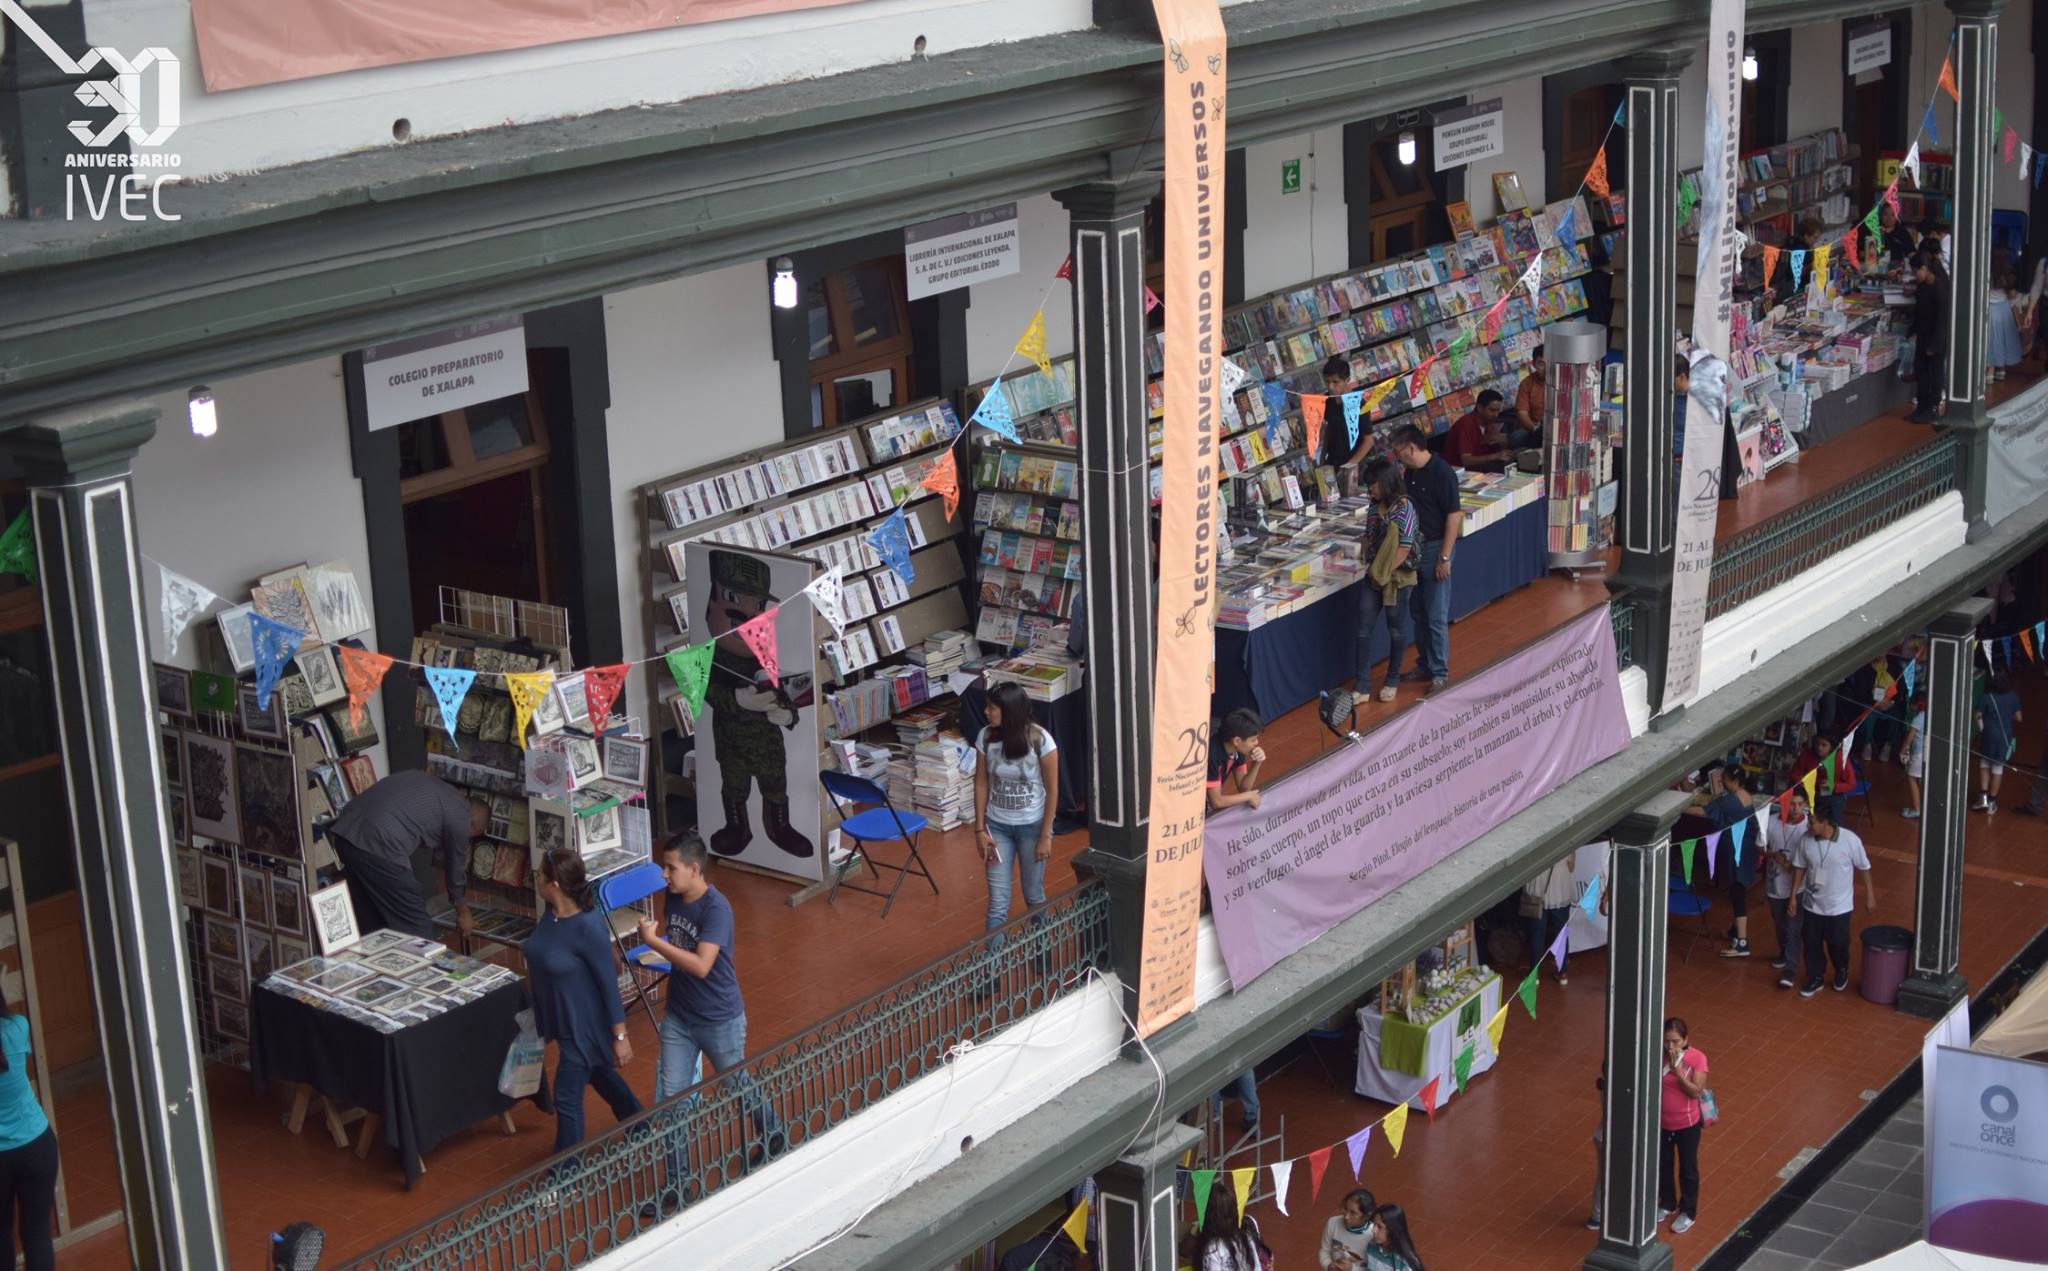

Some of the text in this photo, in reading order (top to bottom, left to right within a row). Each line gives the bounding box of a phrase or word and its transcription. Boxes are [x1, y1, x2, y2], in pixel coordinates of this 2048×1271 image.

[909, 229, 1016, 262] LIBRERÍA INTERNACIONAL DE XALAPA
[928, 259, 1000, 284] GRUPO EDITORIAL ÉXODO
[929, 262, 937, 271] DE
[953, 250, 984, 265] EDICIONES
[1190, 80, 1212, 607] LECTORES NAVEGANDO UNIVERSOS
[388, 350, 504, 387] COLEGIO PREPARATORIO
[422, 375, 475, 397] DE XALAPA
[1682, 539, 1709, 553] 21 AL
[1677, 556, 1712, 573] DE JUL
[1175, 721, 1208, 771] 28
[1175, 769, 1198, 781] Nacional
[1226, 855, 1257, 880] sobre
[1260, 848, 1272, 863] su
[1271, 829, 1306, 855] cuerpo,
[1307, 818, 1320, 834] un
[1321, 805, 1344, 825] topo
[1345, 794, 1363, 815] que
[1365, 782, 1386, 801] cava
[1388, 773, 1399, 788] en
[1400, 767, 1411, 781] su
[1453, 735, 1466, 750] soy
[1469, 714, 1500, 742] también
[1500, 710, 1511, 722] su
[1555, 679, 1566, 692] su
[1227, 839, 1242, 856] He
[1241, 826, 1264, 847] sido,
[1265, 804, 1303, 833] durante
[1367, 760, 1380, 776] un
[1383, 741, 1417, 769] amante
[1418, 733, 1430, 749] de
[1431, 728, 1439, 742] la
[1472, 703, 1482, 718] he
[1224, 892, 1230, 911] y
[1232, 885, 1244, 901] su
[1247, 862, 1294, 891] verdugo,
[1294, 850, 1303, 868] el
[1303, 834, 1330, 862] ángel
[1330, 829, 1342, 845] de
[1342, 822, 1352, 838] la
[1353, 803, 1386, 836] guarda
[1386, 798, 1393, 816] y
[1394, 792, 1404, 807] la
[1405, 777, 1433, 802] aviesa
[1474, 746, 1483, 760] la
[1523, 718, 1531, 732] el
[1532, 703, 1554, 728] árbol
[1554, 703, 1562, 720] y
[1161, 823, 1178, 838] 21
[1182, 816, 1198, 834] AL
[1349, 862, 1373, 883] Sergio
[1391, 836, 1413, 857] Elogio
[1413, 827, 1423, 842] del
[1454, 795, 1479, 817] historia
[1479, 789, 1487, 802] de
[1488, 783, 1500, 797] una
[1500, 770, 1524, 792] pasión
[1155, 846, 1178, 863] DE
[1980, 1132, 2016, 1147] once
[1981, 1122, 2016, 1138] canal
